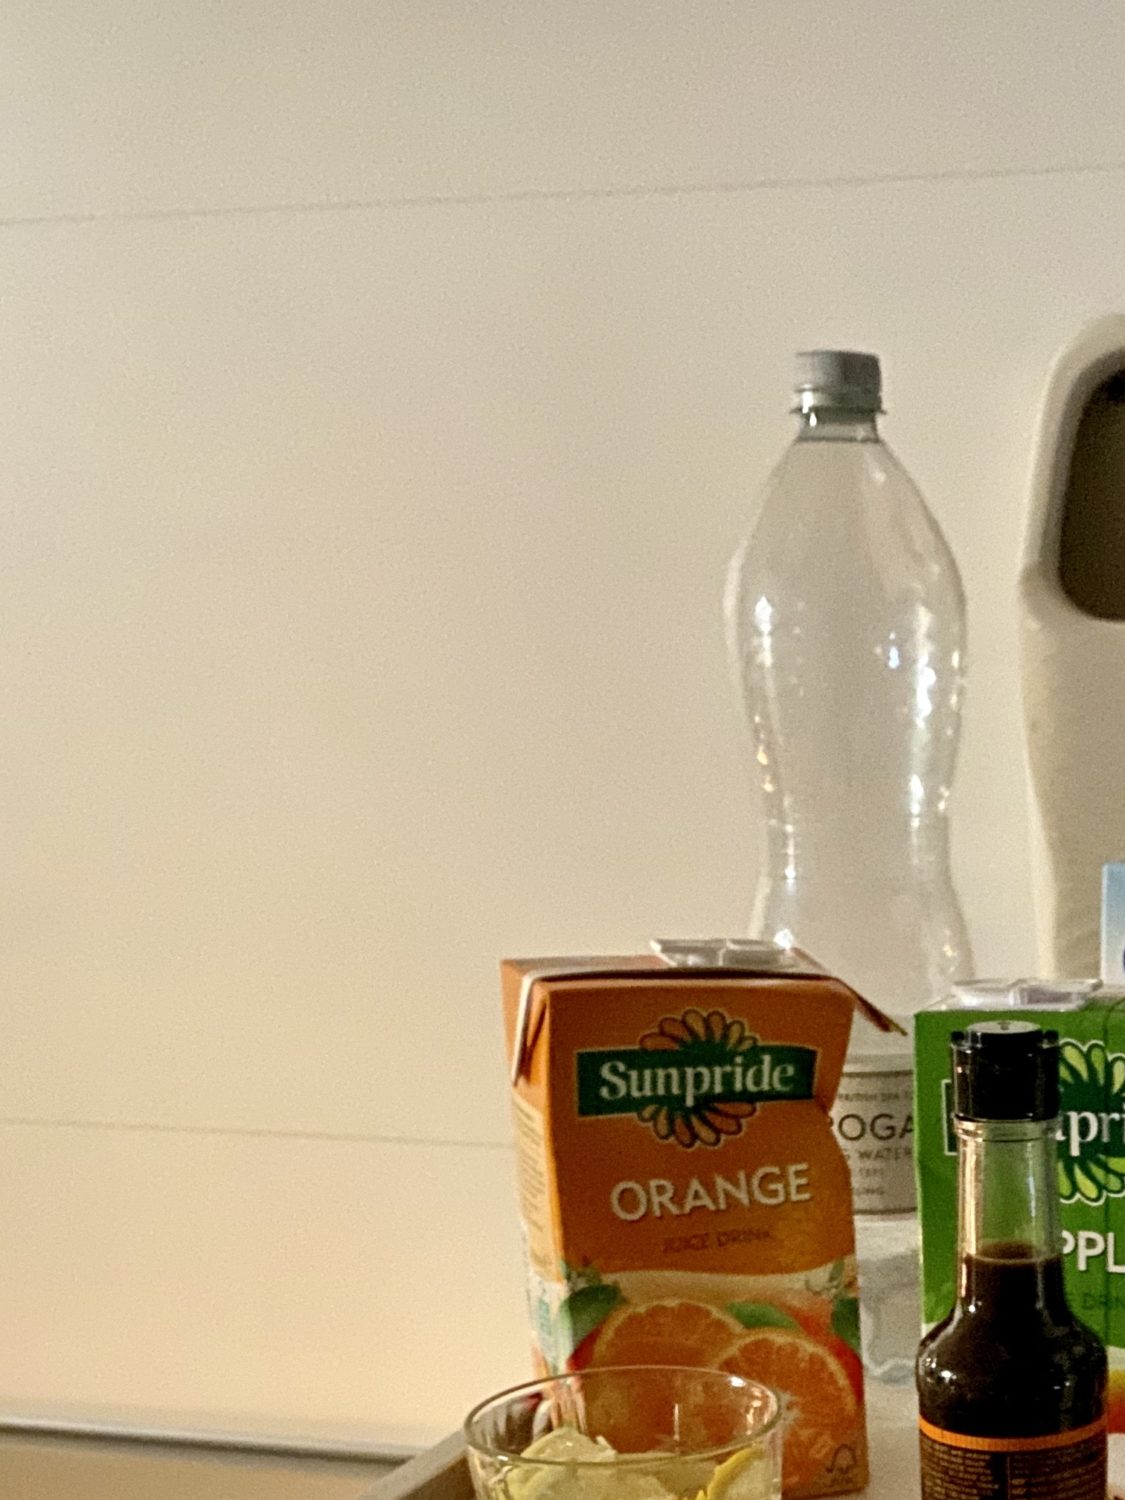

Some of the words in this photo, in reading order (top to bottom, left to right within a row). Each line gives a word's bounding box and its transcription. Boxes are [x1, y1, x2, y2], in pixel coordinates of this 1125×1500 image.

[600, 1054, 796, 1108] Sunpride
[831, 1112, 914, 1141] OGA
[610, 1162, 812, 1221] ORANGE
